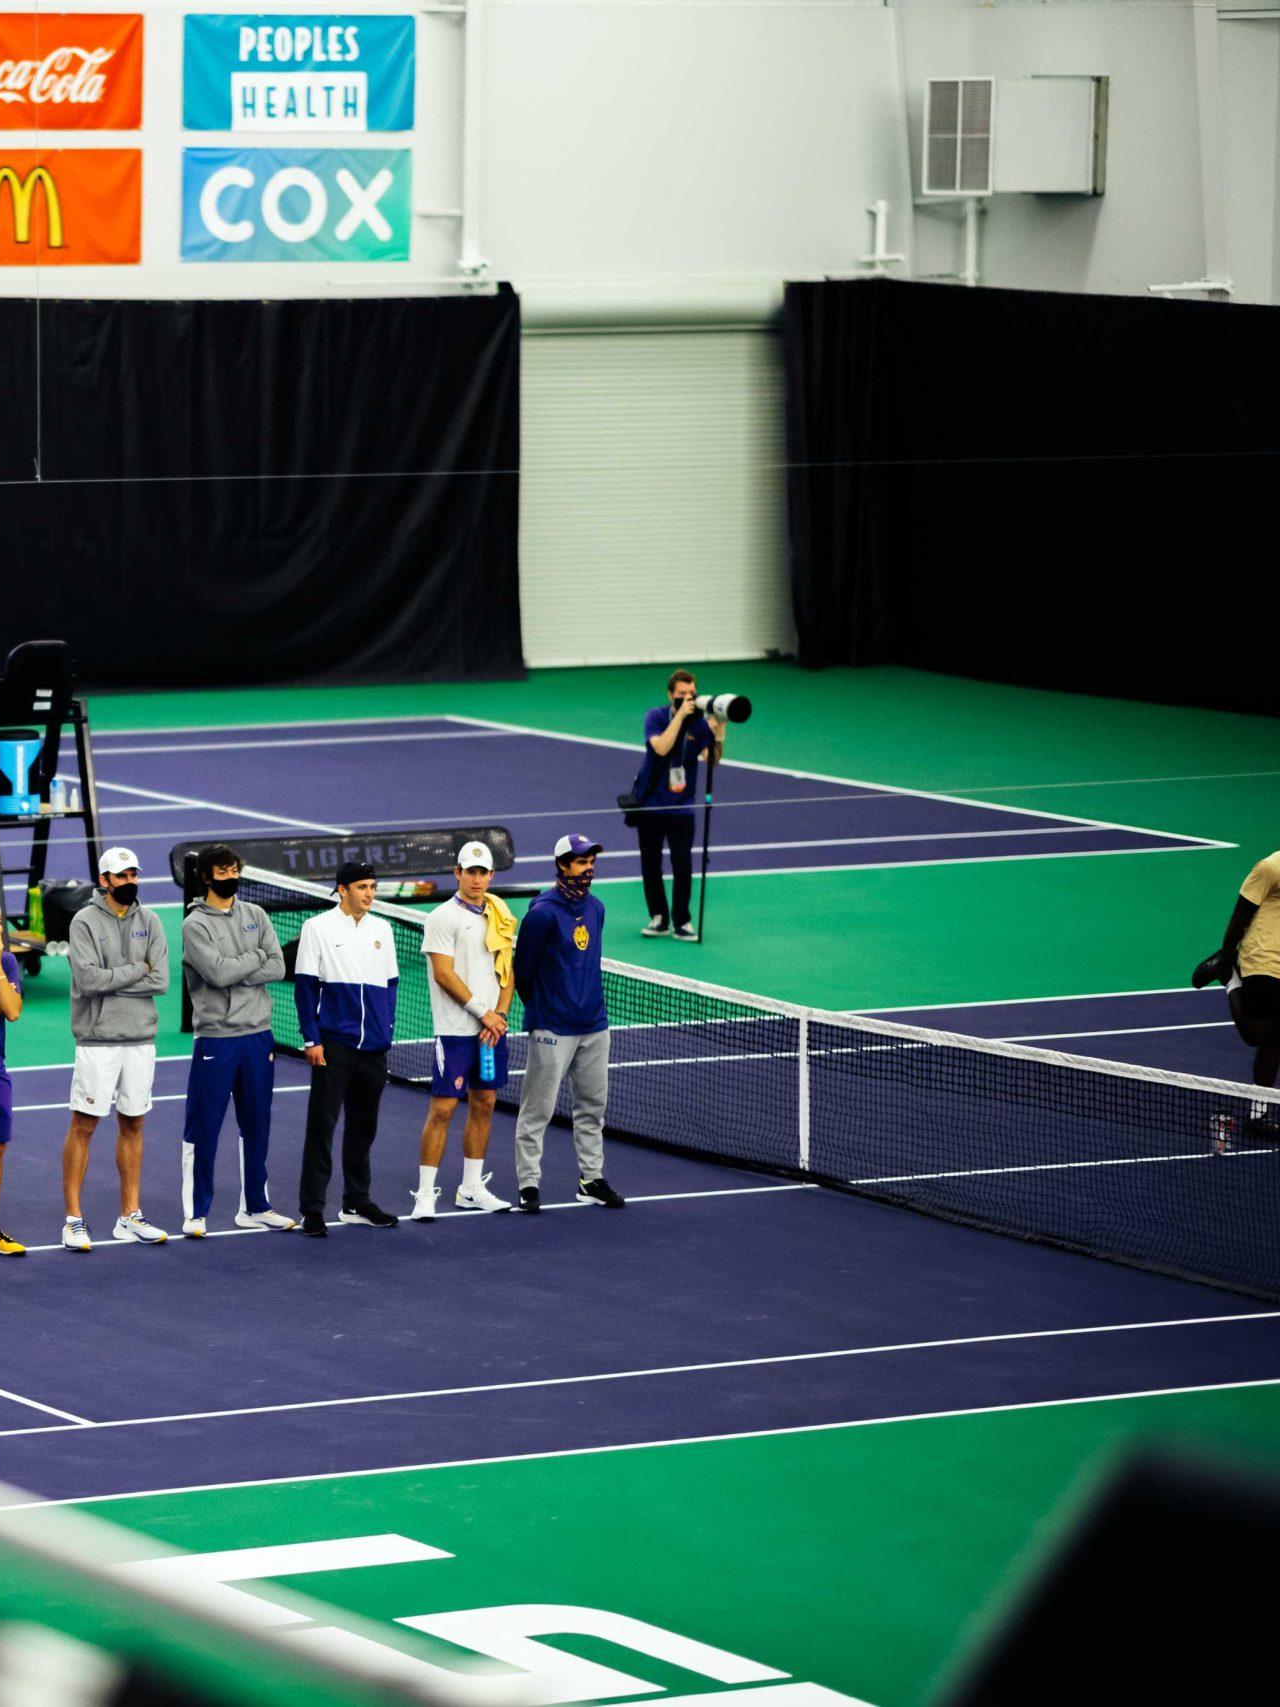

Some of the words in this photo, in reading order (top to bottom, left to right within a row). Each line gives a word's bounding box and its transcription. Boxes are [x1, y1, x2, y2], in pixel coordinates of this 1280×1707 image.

[238, 26, 360, 62] PEOPLES
[241, 85, 359, 119] HEALTH
[199, 167, 393, 243] COX
[283, 844, 407, 871] TIGERS
[536, 1035, 558, 1046] LSU
[105, 1533, 880, 1707] LS
